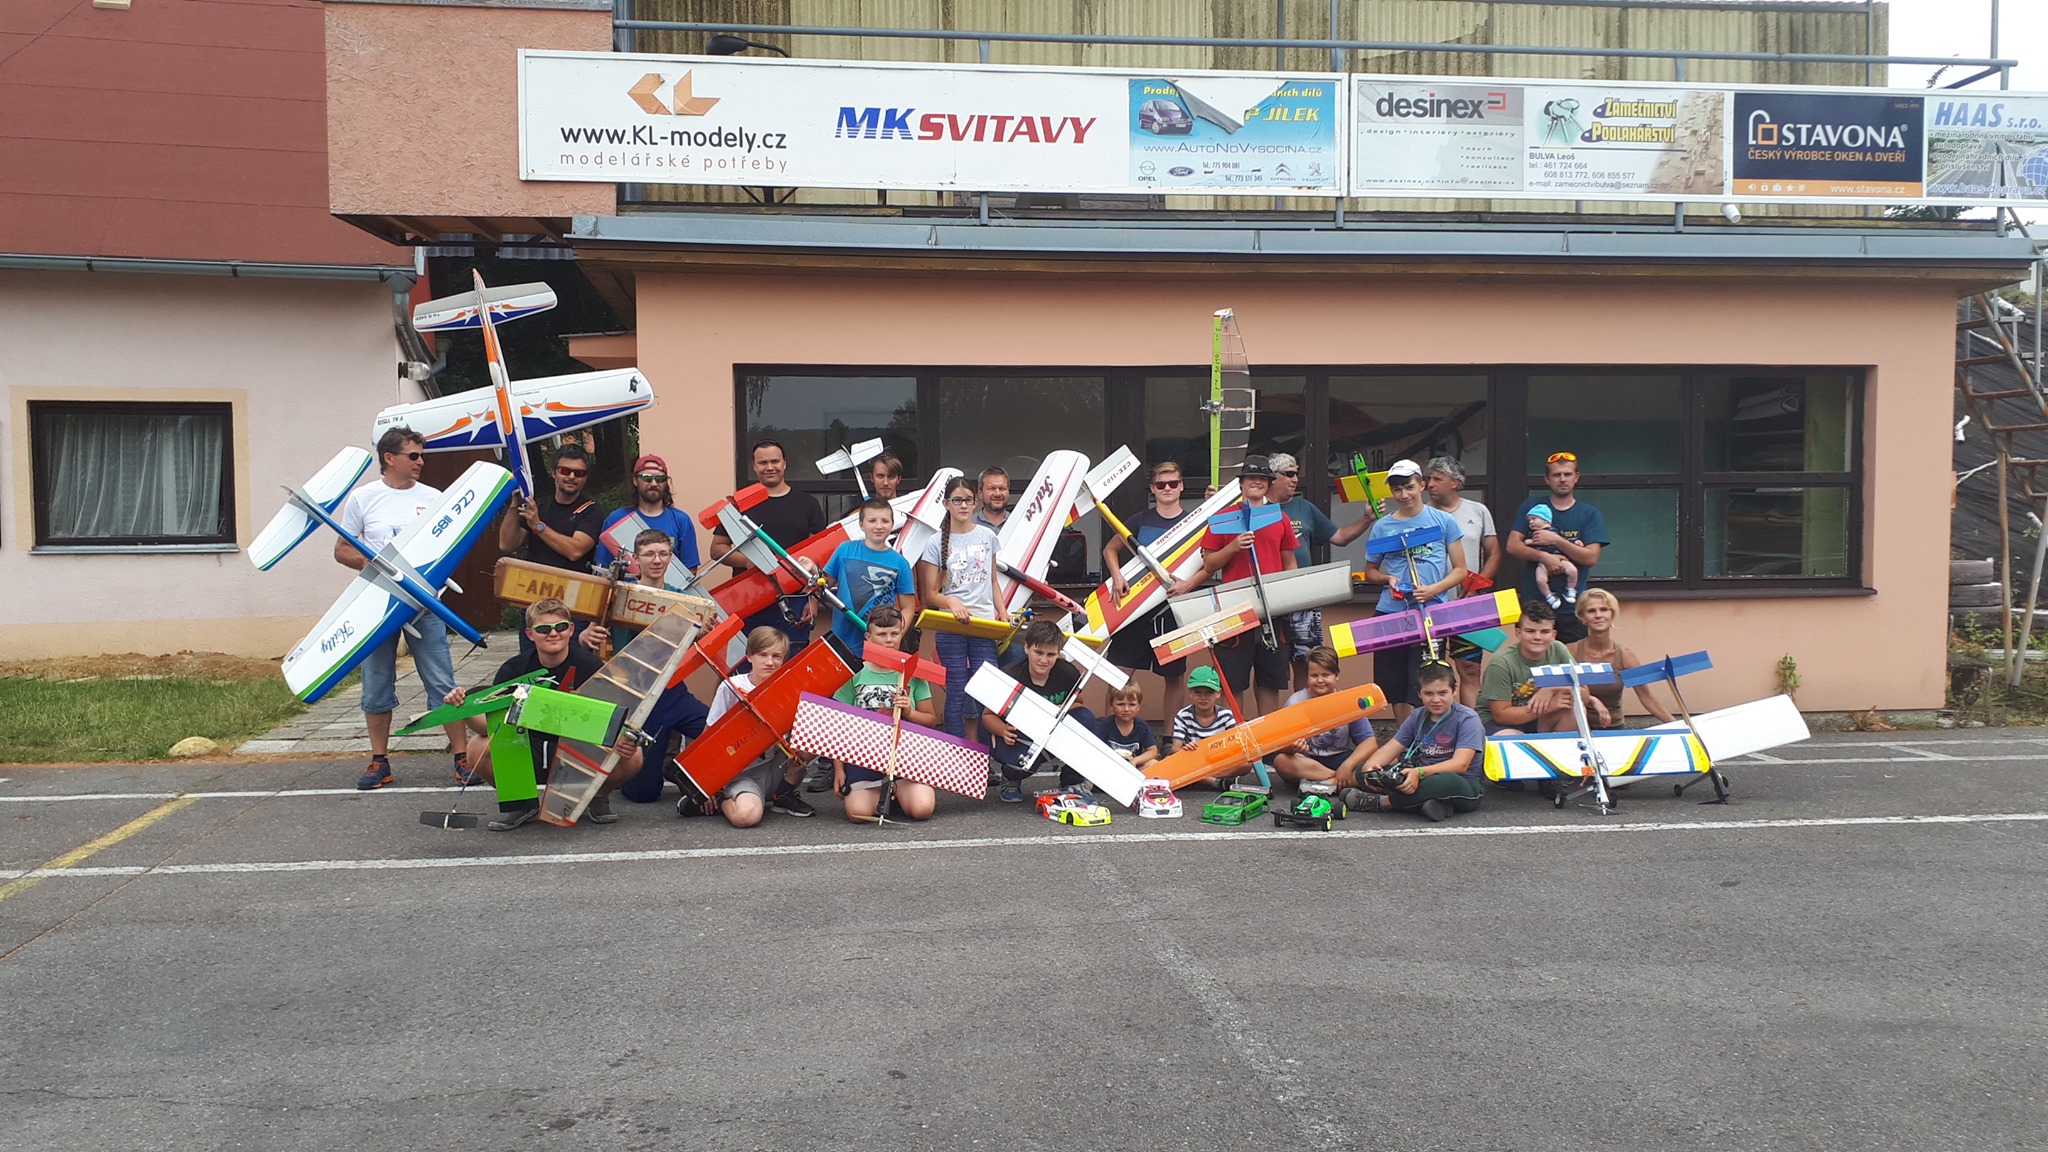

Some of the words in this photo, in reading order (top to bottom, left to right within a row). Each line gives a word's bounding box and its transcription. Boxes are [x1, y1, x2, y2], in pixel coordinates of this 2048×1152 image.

[1262, 103, 1321, 122] JÍLEK
[1376, 92, 1485, 119] desinex
[1934, 101, 2005, 128] HAAS
[2006, 117, 2042, 129] s.r.o.
[560, 125, 788, 153] www.KL-modely.cz
[1781, 123, 1906, 149] STAVONA
[560, 151, 691, 168] modelářské
[704, 153, 787, 173] potřeby
[1529, 152, 1555, 160] BULVA
[1557, 152, 1576, 160] Leoš
[1748, 147, 1782, 160] ČESKÝ
[1784, 148, 1832, 161] VÝROBCE
[1834, 151, 1863, 161] OKEN
[1866, 152, 1873, 161] A
[1875, 150, 1906, 163] DVEŘÍ
[1622, 172, 1635, 180] 577
[1830, 185, 1906, 194] www.stavona.cz
[451, 489, 476, 515] CZE
[627, 598, 657, 616] CZE
